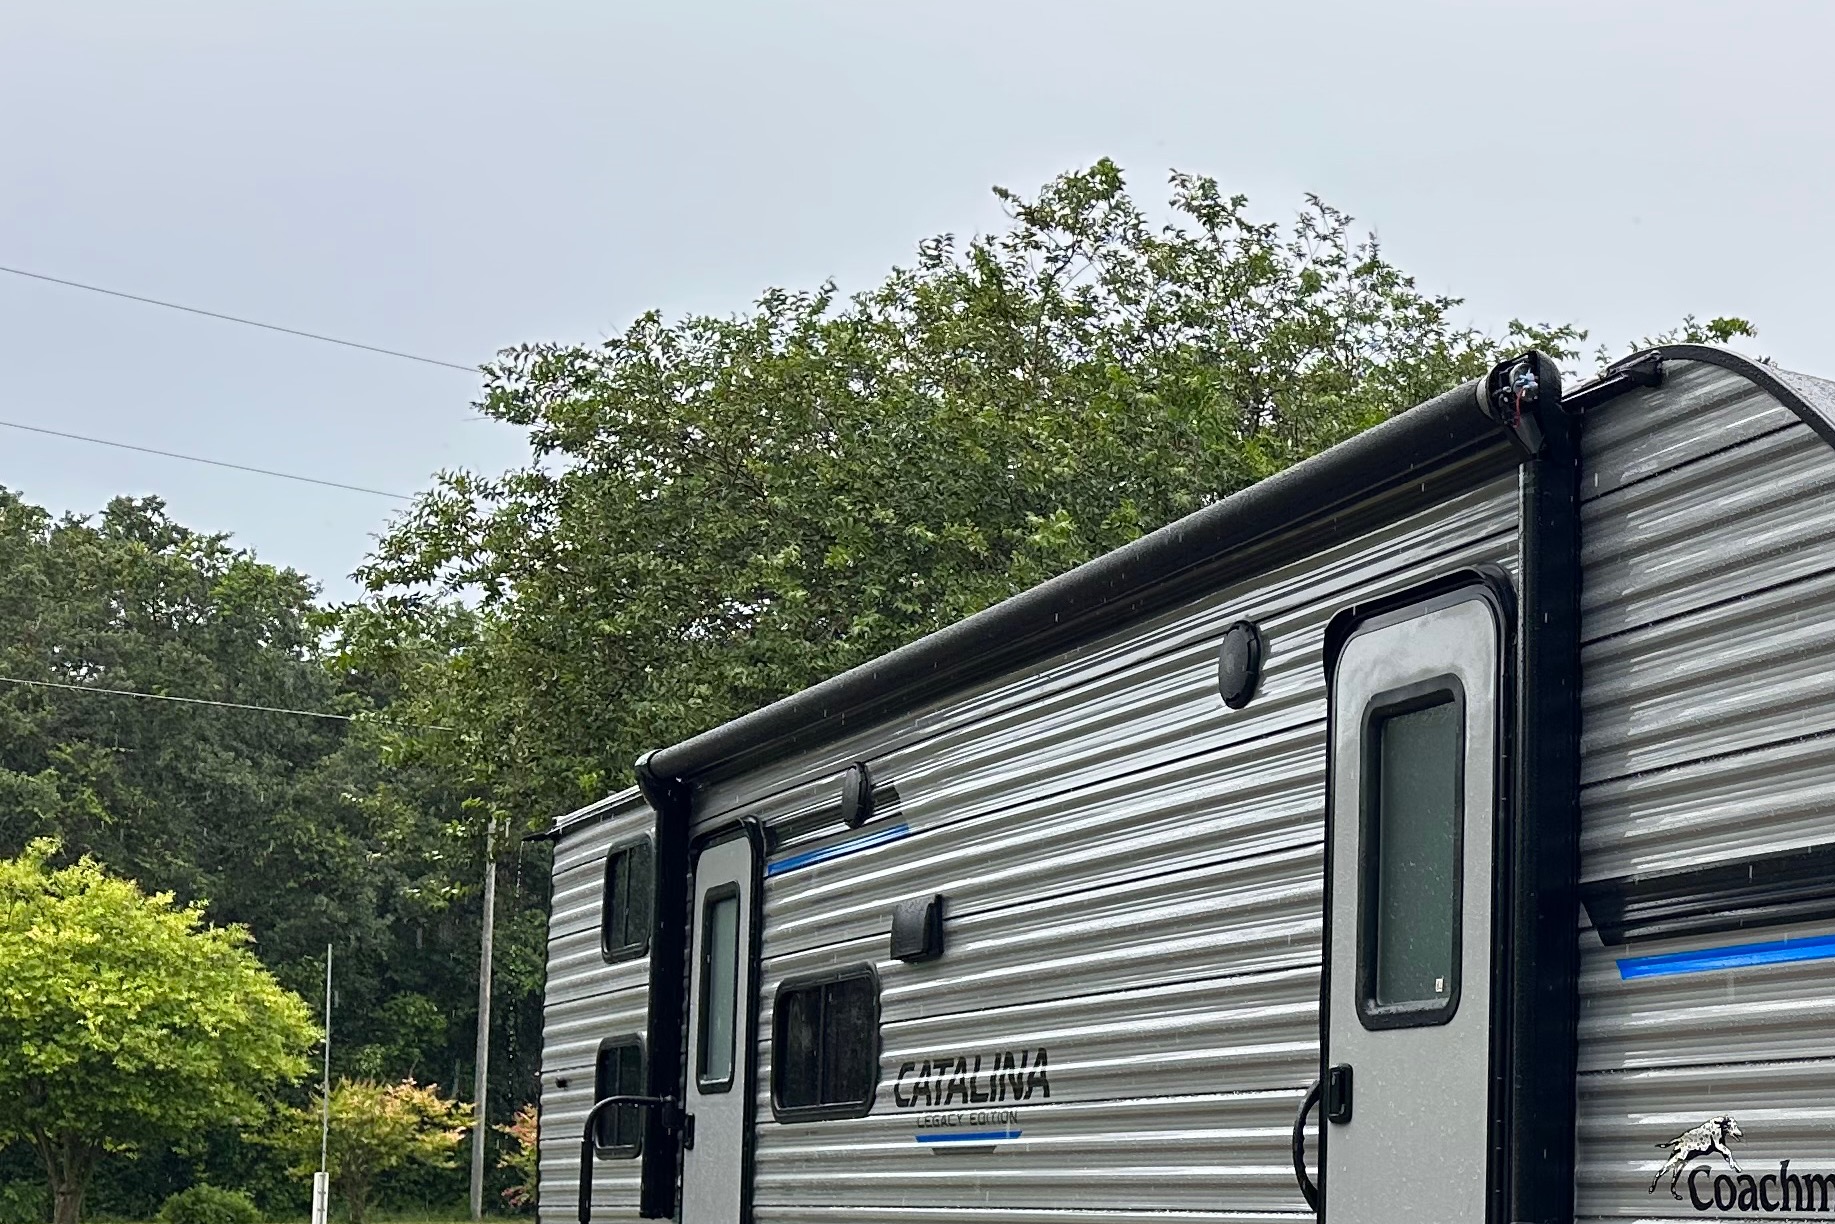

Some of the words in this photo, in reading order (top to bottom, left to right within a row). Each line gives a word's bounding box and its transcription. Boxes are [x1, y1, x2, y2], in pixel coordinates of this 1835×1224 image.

[893, 1047, 1051, 1107] CATALINA
[916, 1113, 964, 1129] LEGACY
[969, 1110, 1018, 1126] EDITION
